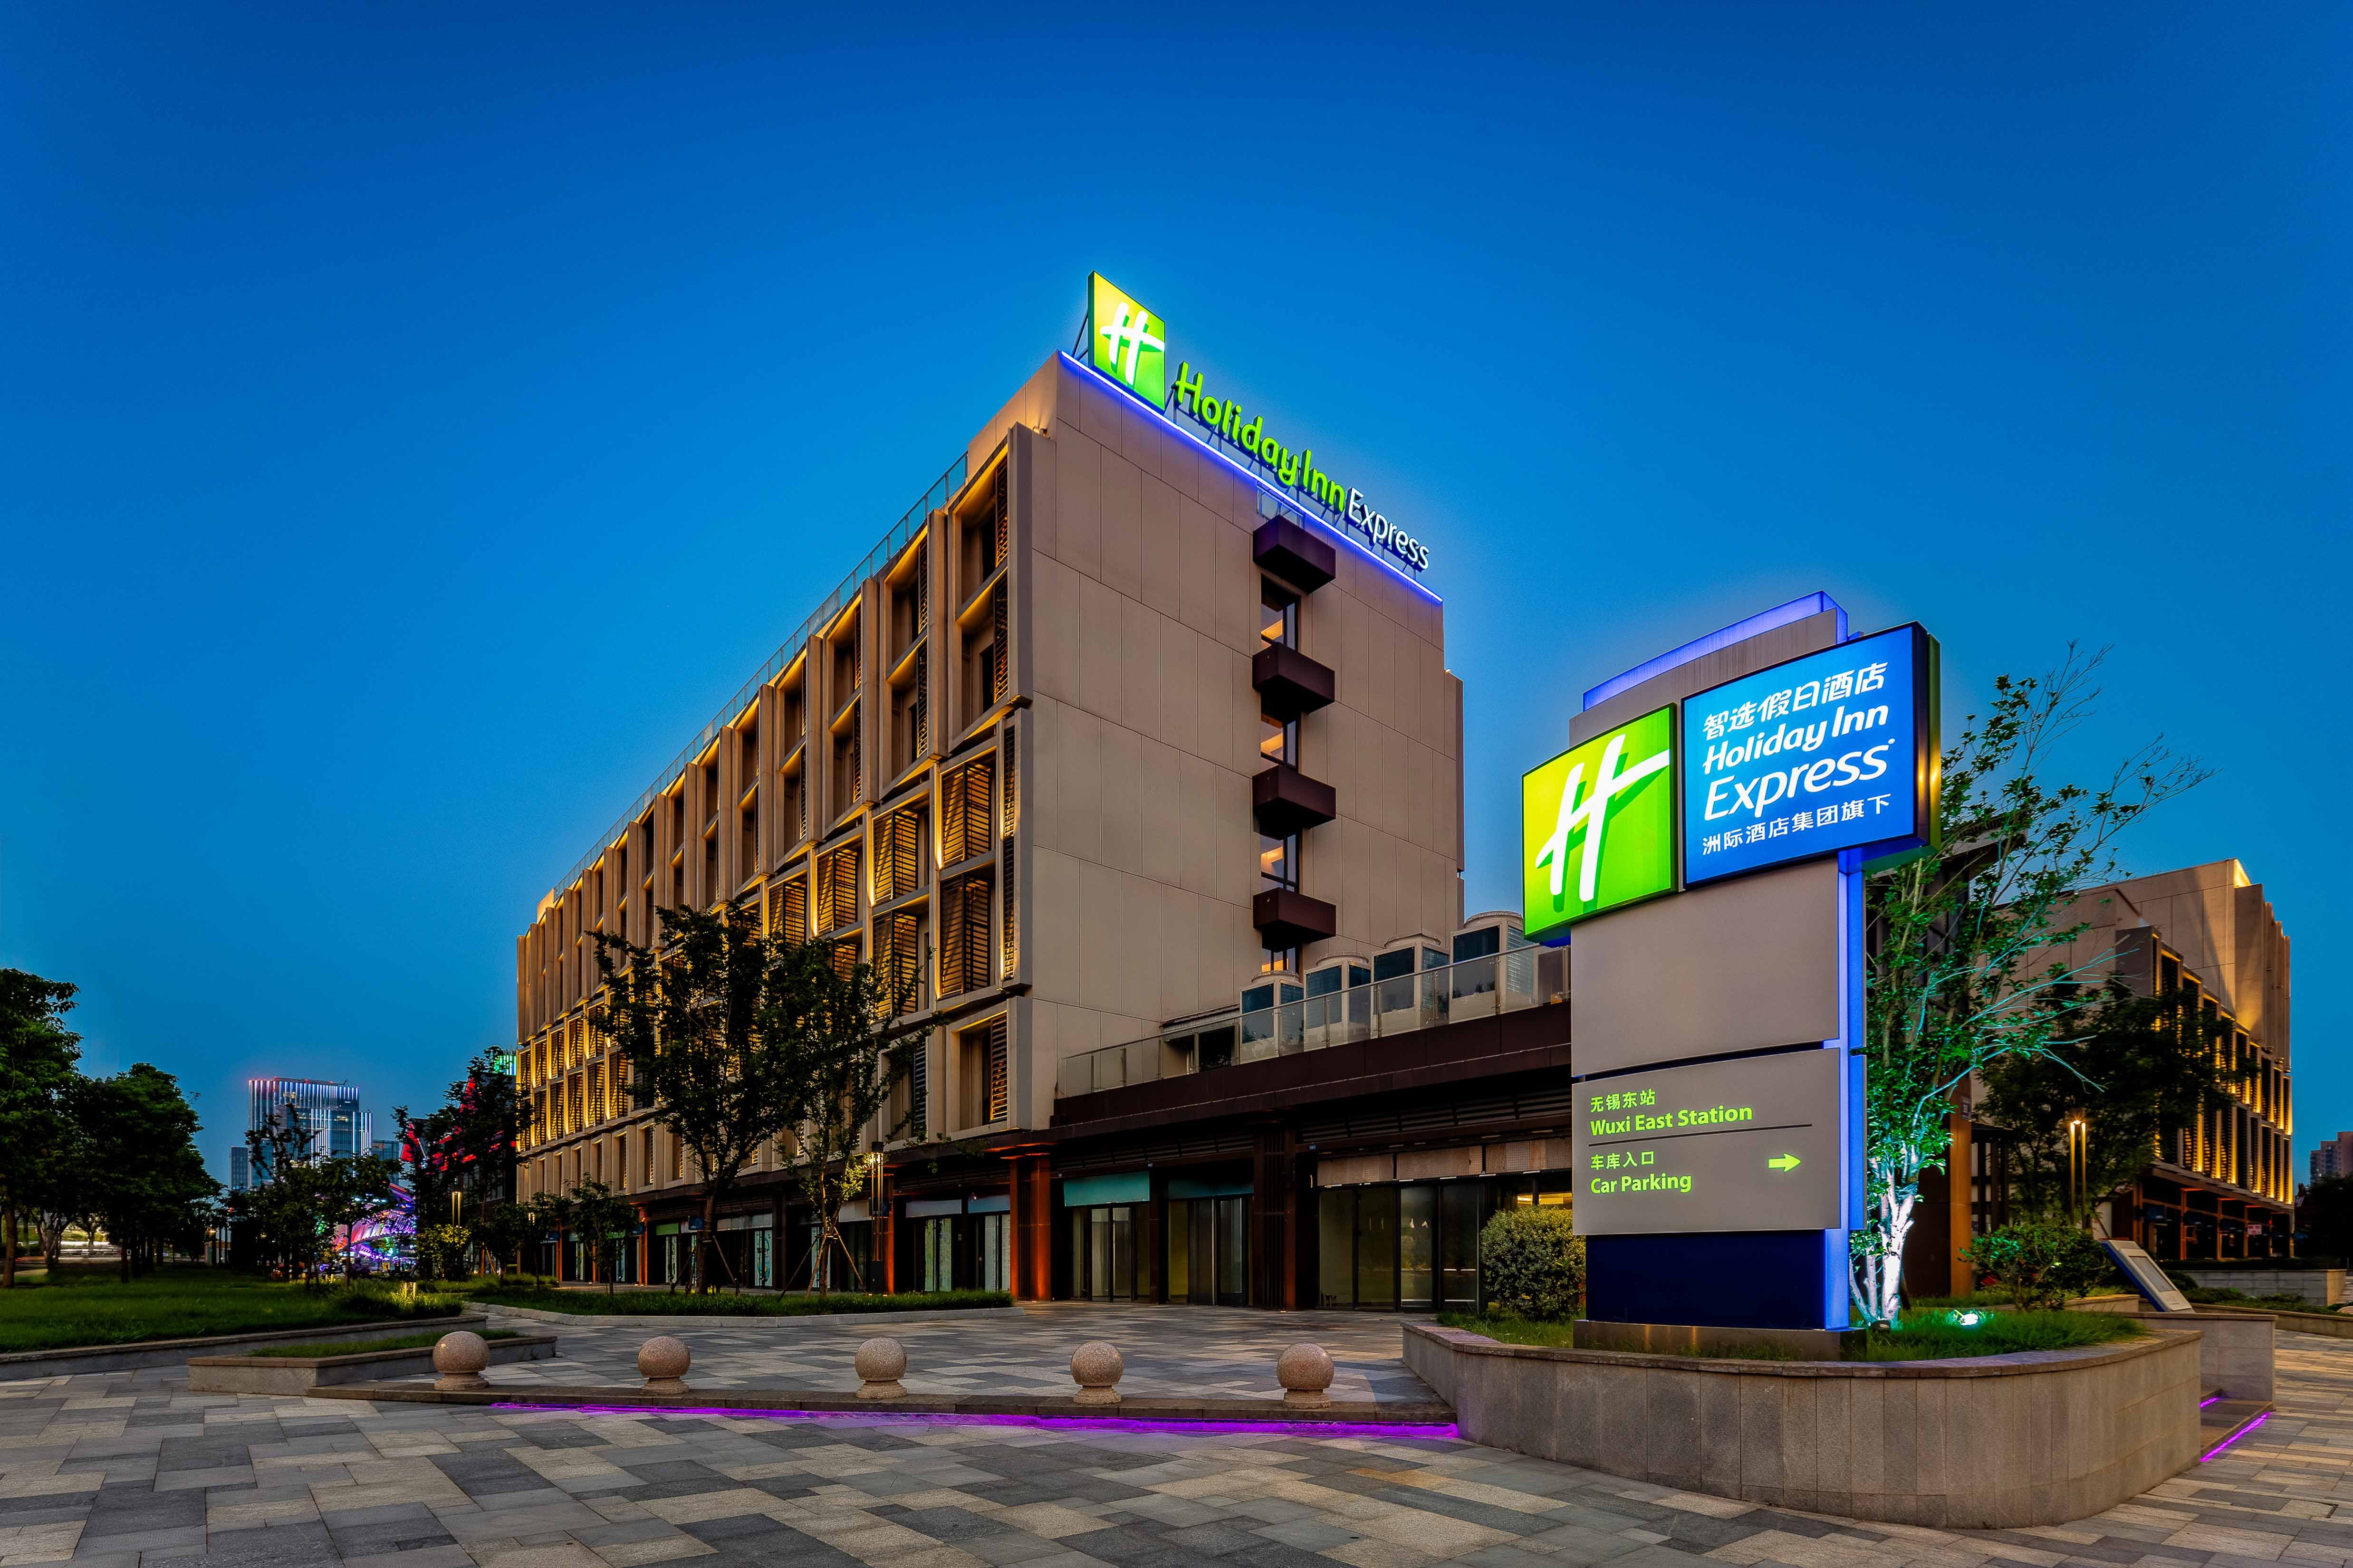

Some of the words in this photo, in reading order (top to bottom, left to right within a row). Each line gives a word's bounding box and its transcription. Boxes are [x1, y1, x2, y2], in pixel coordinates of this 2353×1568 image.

[1174, 361, 1299, 486] Holiday
[1302, 449, 1345, 513] Inn
[1348, 486, 1430, 570] Express
[1702, 662, 1888, 741] 智选假日酒店
[1702, 720, 1828, 774] Holiday
[1831, 705, 1889, 737] Inn
[1704, 744, 1889, 822] Express
[1702, 793, 1892, 856] 洲际酒店集团旗下
[1590, 1088, 1656, 1114] 无锡东站
[1590, 1116, 1631, 1136] Wuxi
[1634, 1112, 1673, 1131] East
[1677, 1105, 1753, 1127] Station
[1590, 1151, 1655, 1171] 车库入口
[1590, 1177, 1617, 1195] Car
[1621, 1172, 1692, 1193] Parking
